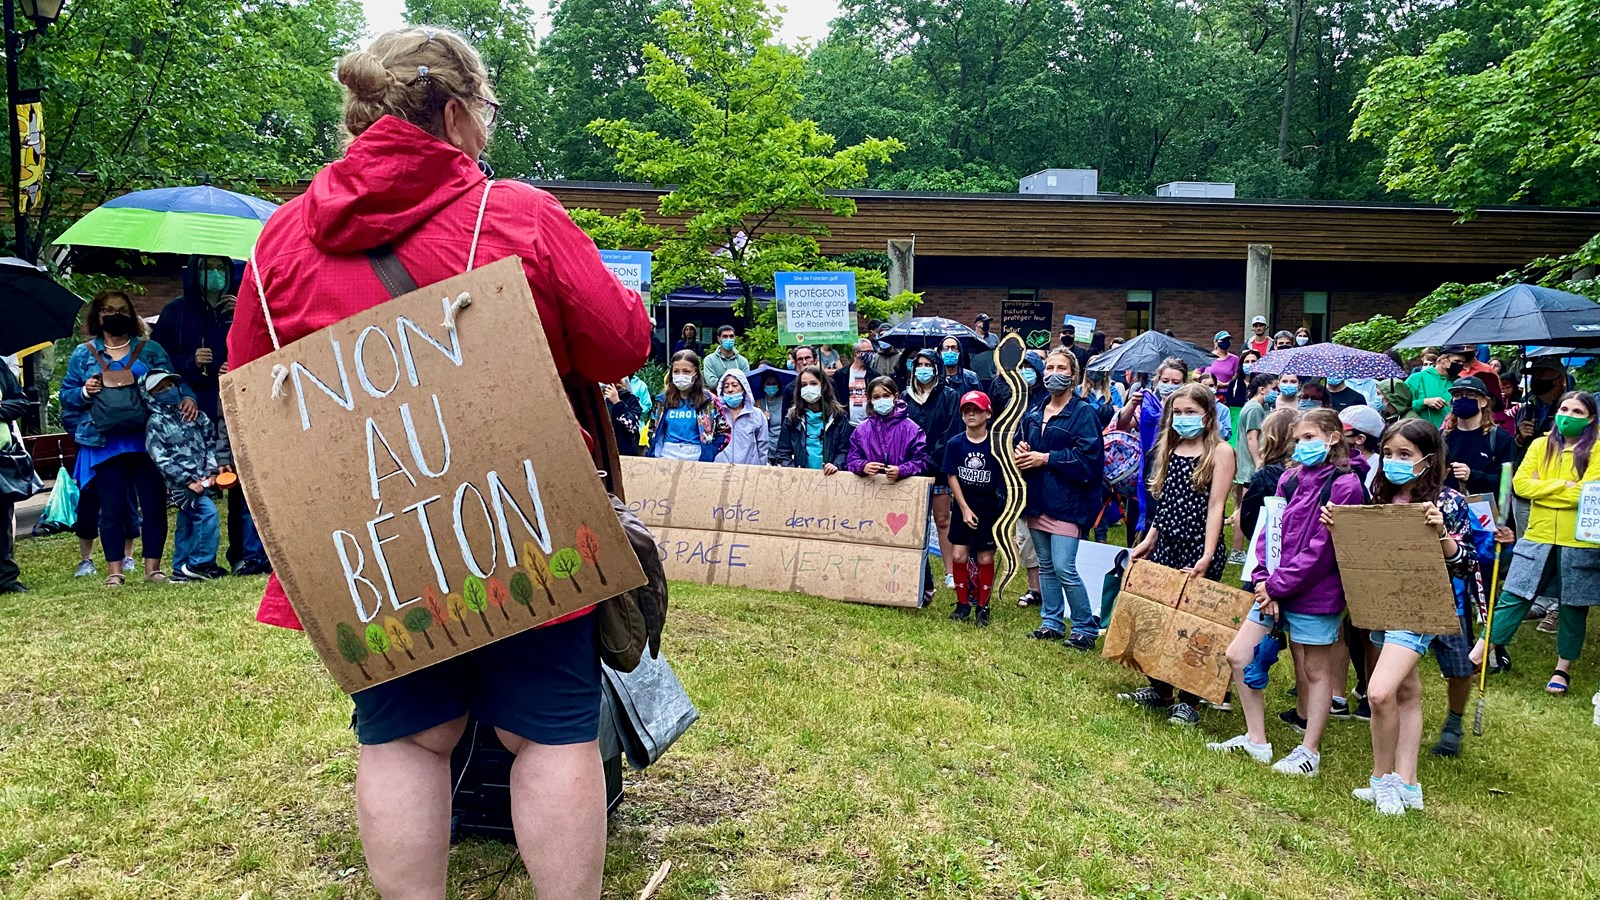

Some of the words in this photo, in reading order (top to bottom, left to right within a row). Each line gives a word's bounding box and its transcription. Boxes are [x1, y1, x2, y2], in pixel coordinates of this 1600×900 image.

[788, 287, 845, 298] PROTÉGEONS
[791, 309, 823, 318] ESPACE
[825, 309, 845, 318] VERT
[797, 300, 823, 308] dernier
[825, 300, 847, 308] grand
[807, 320, 843, 328] Rosemère
[1003, 324, 1021, 332] futur
[290, 297, 463, 431] NON
[366, 394, 450, 500] AU
[957, 466, 991, 483] EXPOS
[777, 474, 914, 501] UNANIMES
[627, 498, 672, 516] ons
[712, 499, 760, 522] notre
[785, 509, 874, 531] dernier
[332, 459, 552, 622] BÉTON
[655, 540, 750, 567] SPACE
[780, 550, 874, 579] VERT
